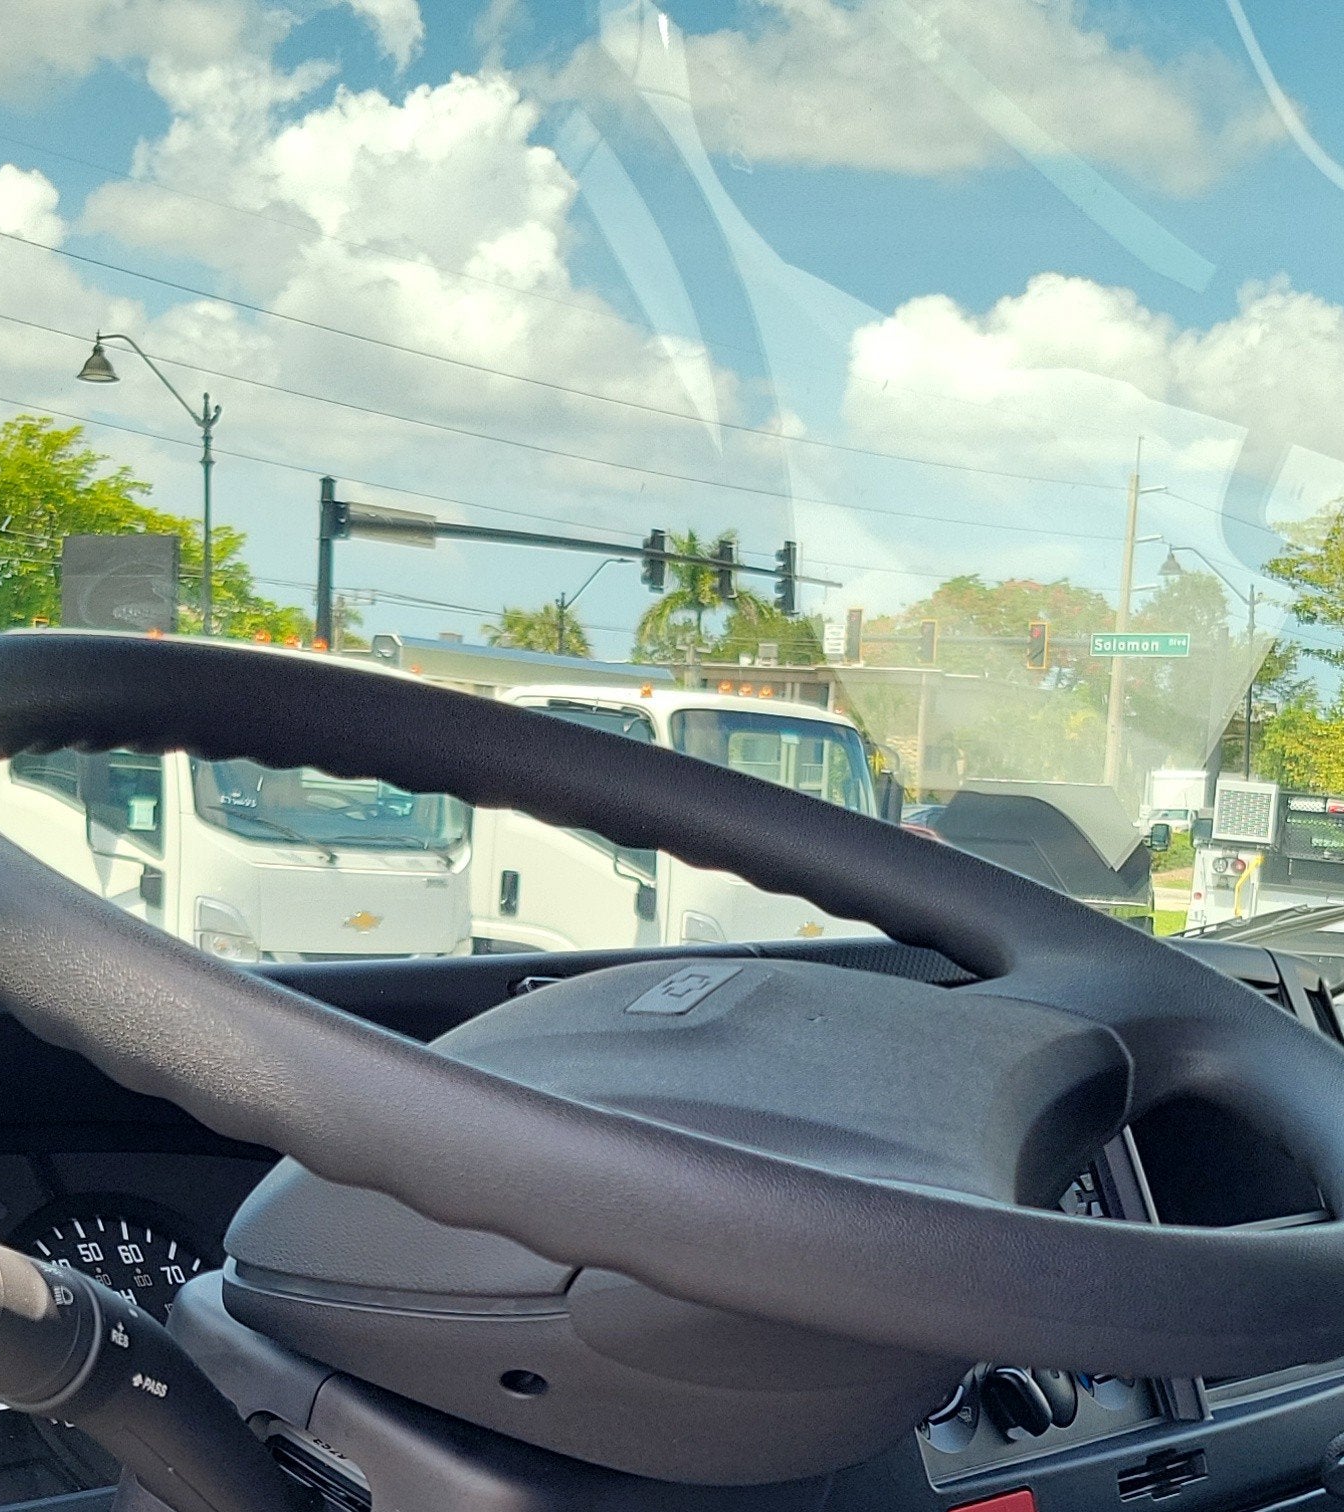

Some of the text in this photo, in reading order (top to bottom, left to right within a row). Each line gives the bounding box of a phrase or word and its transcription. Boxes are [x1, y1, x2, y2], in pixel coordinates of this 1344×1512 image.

[1094, 638, 1186, 652] Solomon Blvd
[77, 1242, 104, 1263] 50
[117, 1244, 144, 1265] 60
[133, 1274, 153, 1288] 100
[160, 1265, 186, 1286] 70
[111, 1328, 130, 1349] RES
[142, 1376, 168, 1398] PASS
